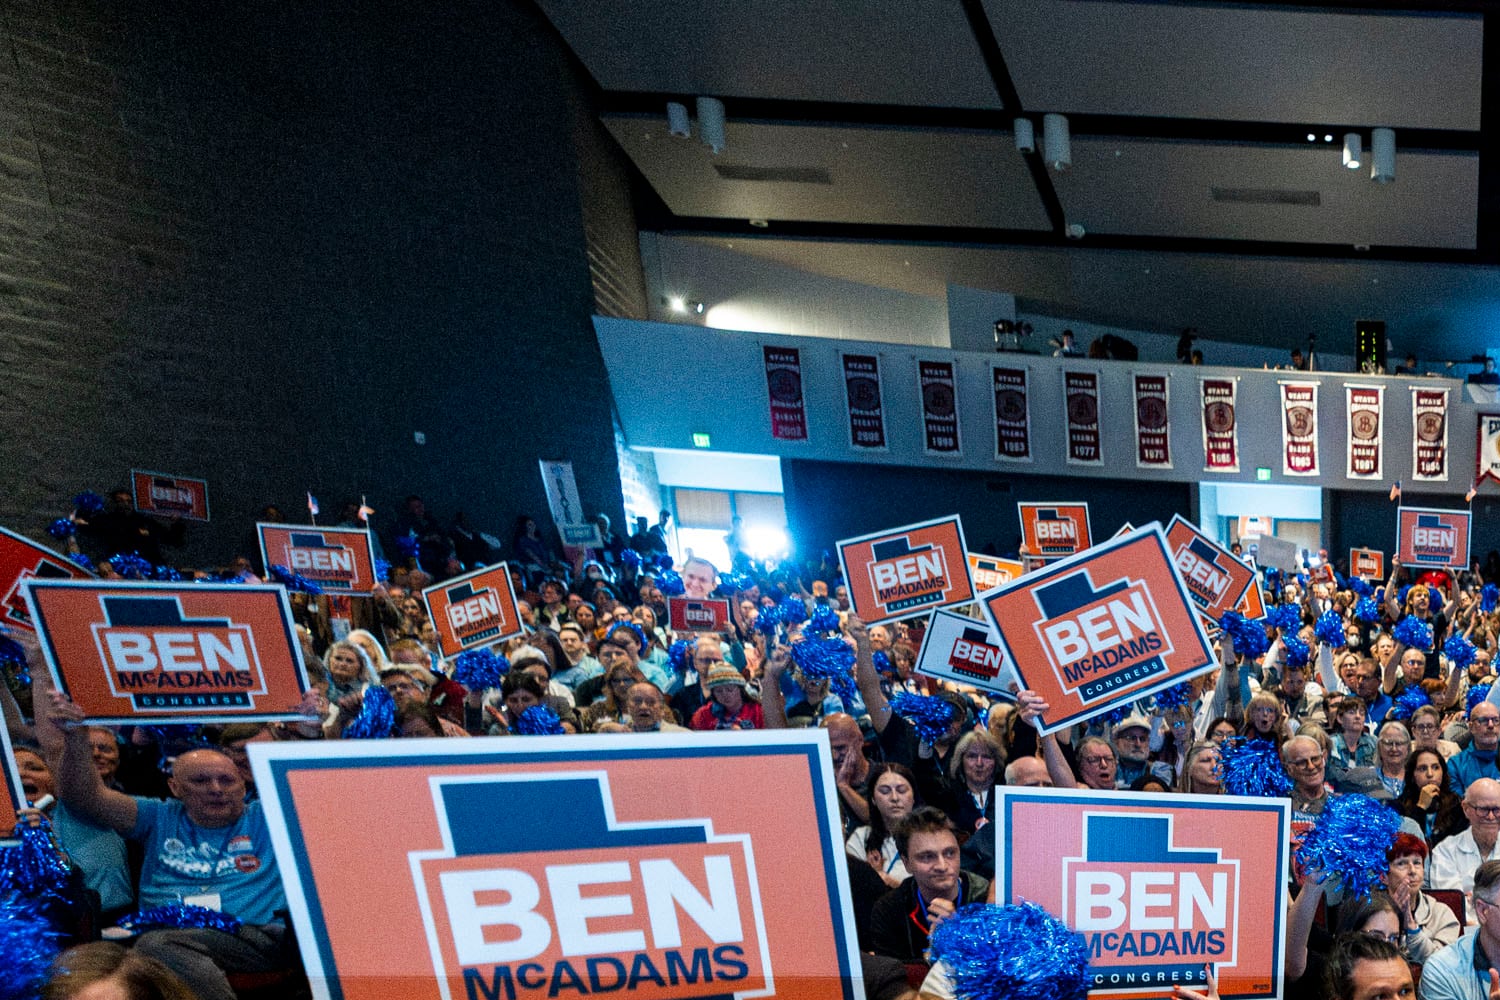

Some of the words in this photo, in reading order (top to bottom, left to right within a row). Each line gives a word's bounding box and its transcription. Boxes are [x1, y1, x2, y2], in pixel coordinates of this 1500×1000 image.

[1075, 446, 1096, 457] 1977
[152, 486, 192, 505] BEN
[1036, 522, 1075, 539] BEN
[1415, 529, 1455, 547] BEN
[290, 549, 352, 571] BEN
[873, 552, 944, 591] BEN
[1176, 550, 1228, 594] BEN
[879, 576, 945, 601] McADAMS
[973, 568, 1009, 587] BEN
[450, 593, 500, 628] BEN
[686, 608, 713, 622] BEN
[1044, 592, 1156, 666] BEN
[104, 632, 251, 673] BEN
[952, 642, 1004, 670] BEN
[1063, 631, 1163, 684] McADAMS
[117, 669, 255, 689] McADAMS
[1086, 661, 1160, 697] CONGRESS
[439, 855, 743, 965] BEN
[1075, 871, 1228, 932] BEN
[1086, 929, 1226, 959] McADAMS
[1094, 970, 1208, 985] CONGRESS
